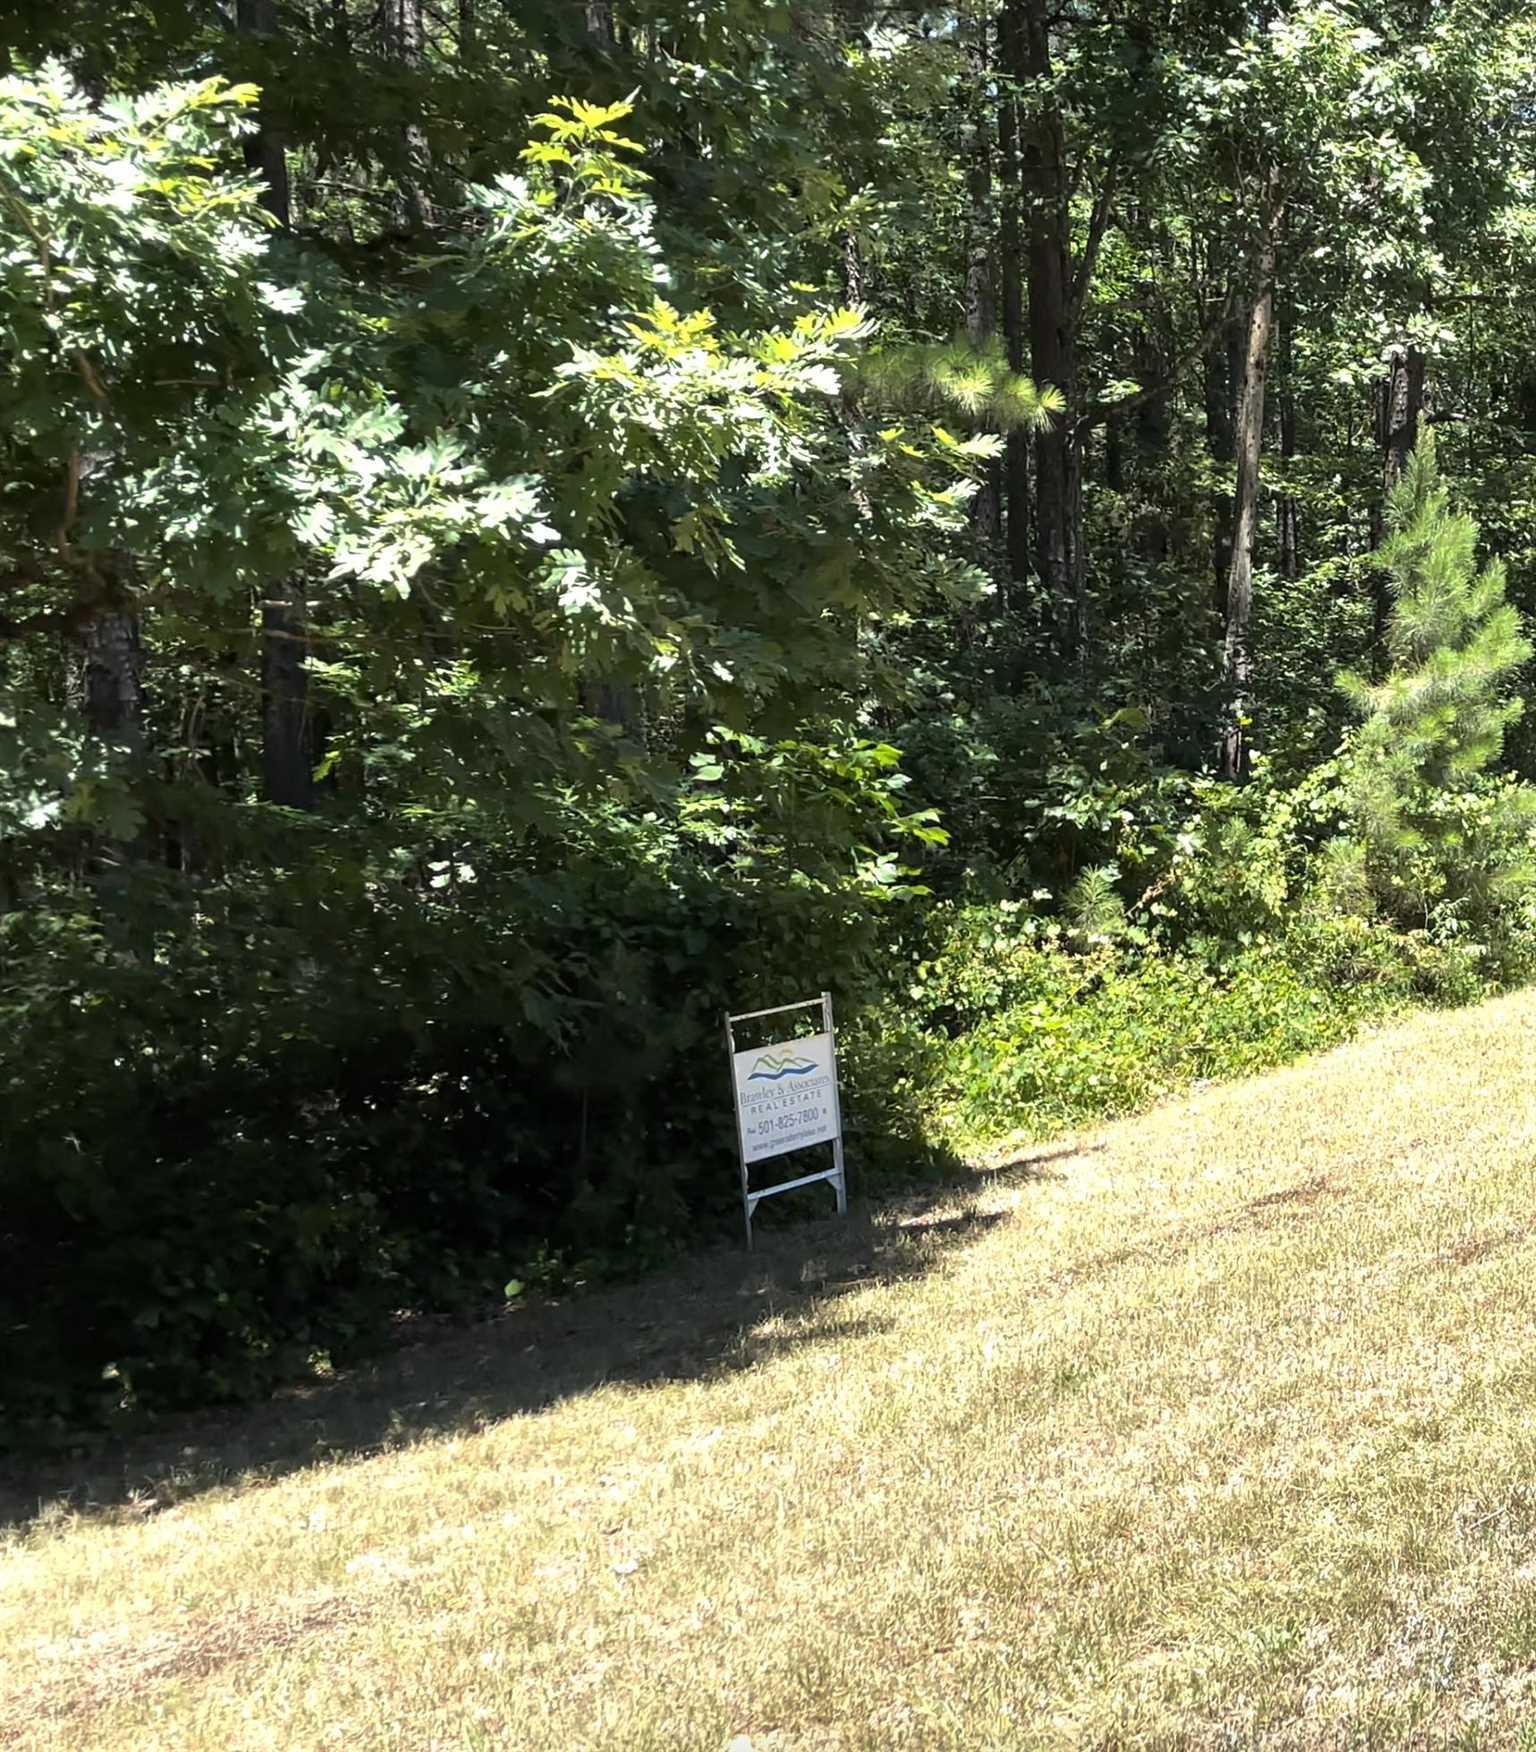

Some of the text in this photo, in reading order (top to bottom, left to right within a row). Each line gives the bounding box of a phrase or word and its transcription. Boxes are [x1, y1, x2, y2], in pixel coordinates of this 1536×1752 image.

[751, 1089, 821, 1113] REAL ESTATE
[758, 1107, 819, 1135] 501-825-7800
